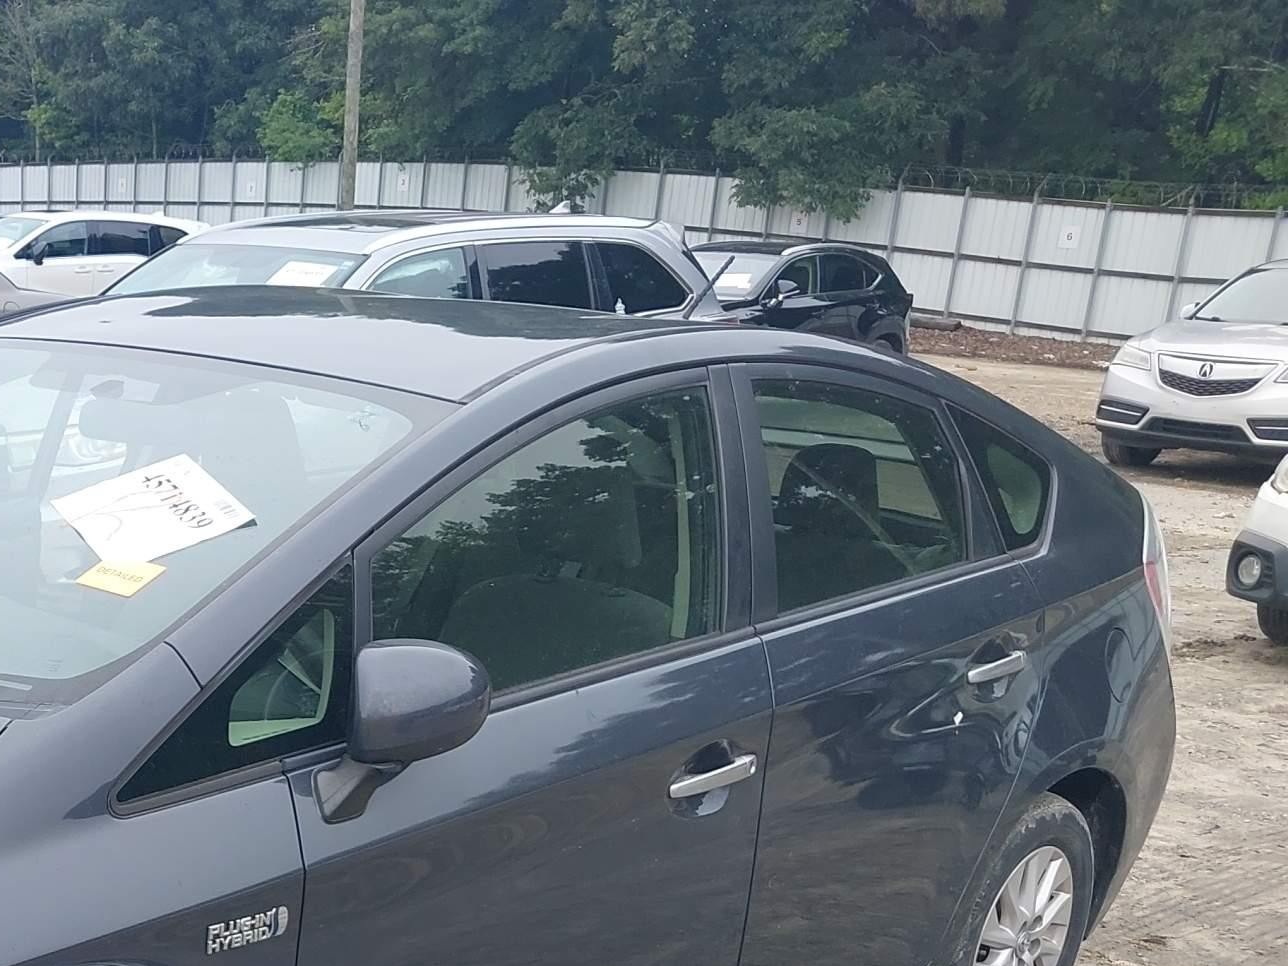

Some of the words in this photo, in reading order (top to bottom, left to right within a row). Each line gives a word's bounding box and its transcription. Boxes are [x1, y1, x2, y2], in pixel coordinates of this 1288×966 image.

[95, 565, 144, 584] DETAILED
[207, 910, 274, 940] PLUG-IN
[206, 926, 272, 956] HYBRID
